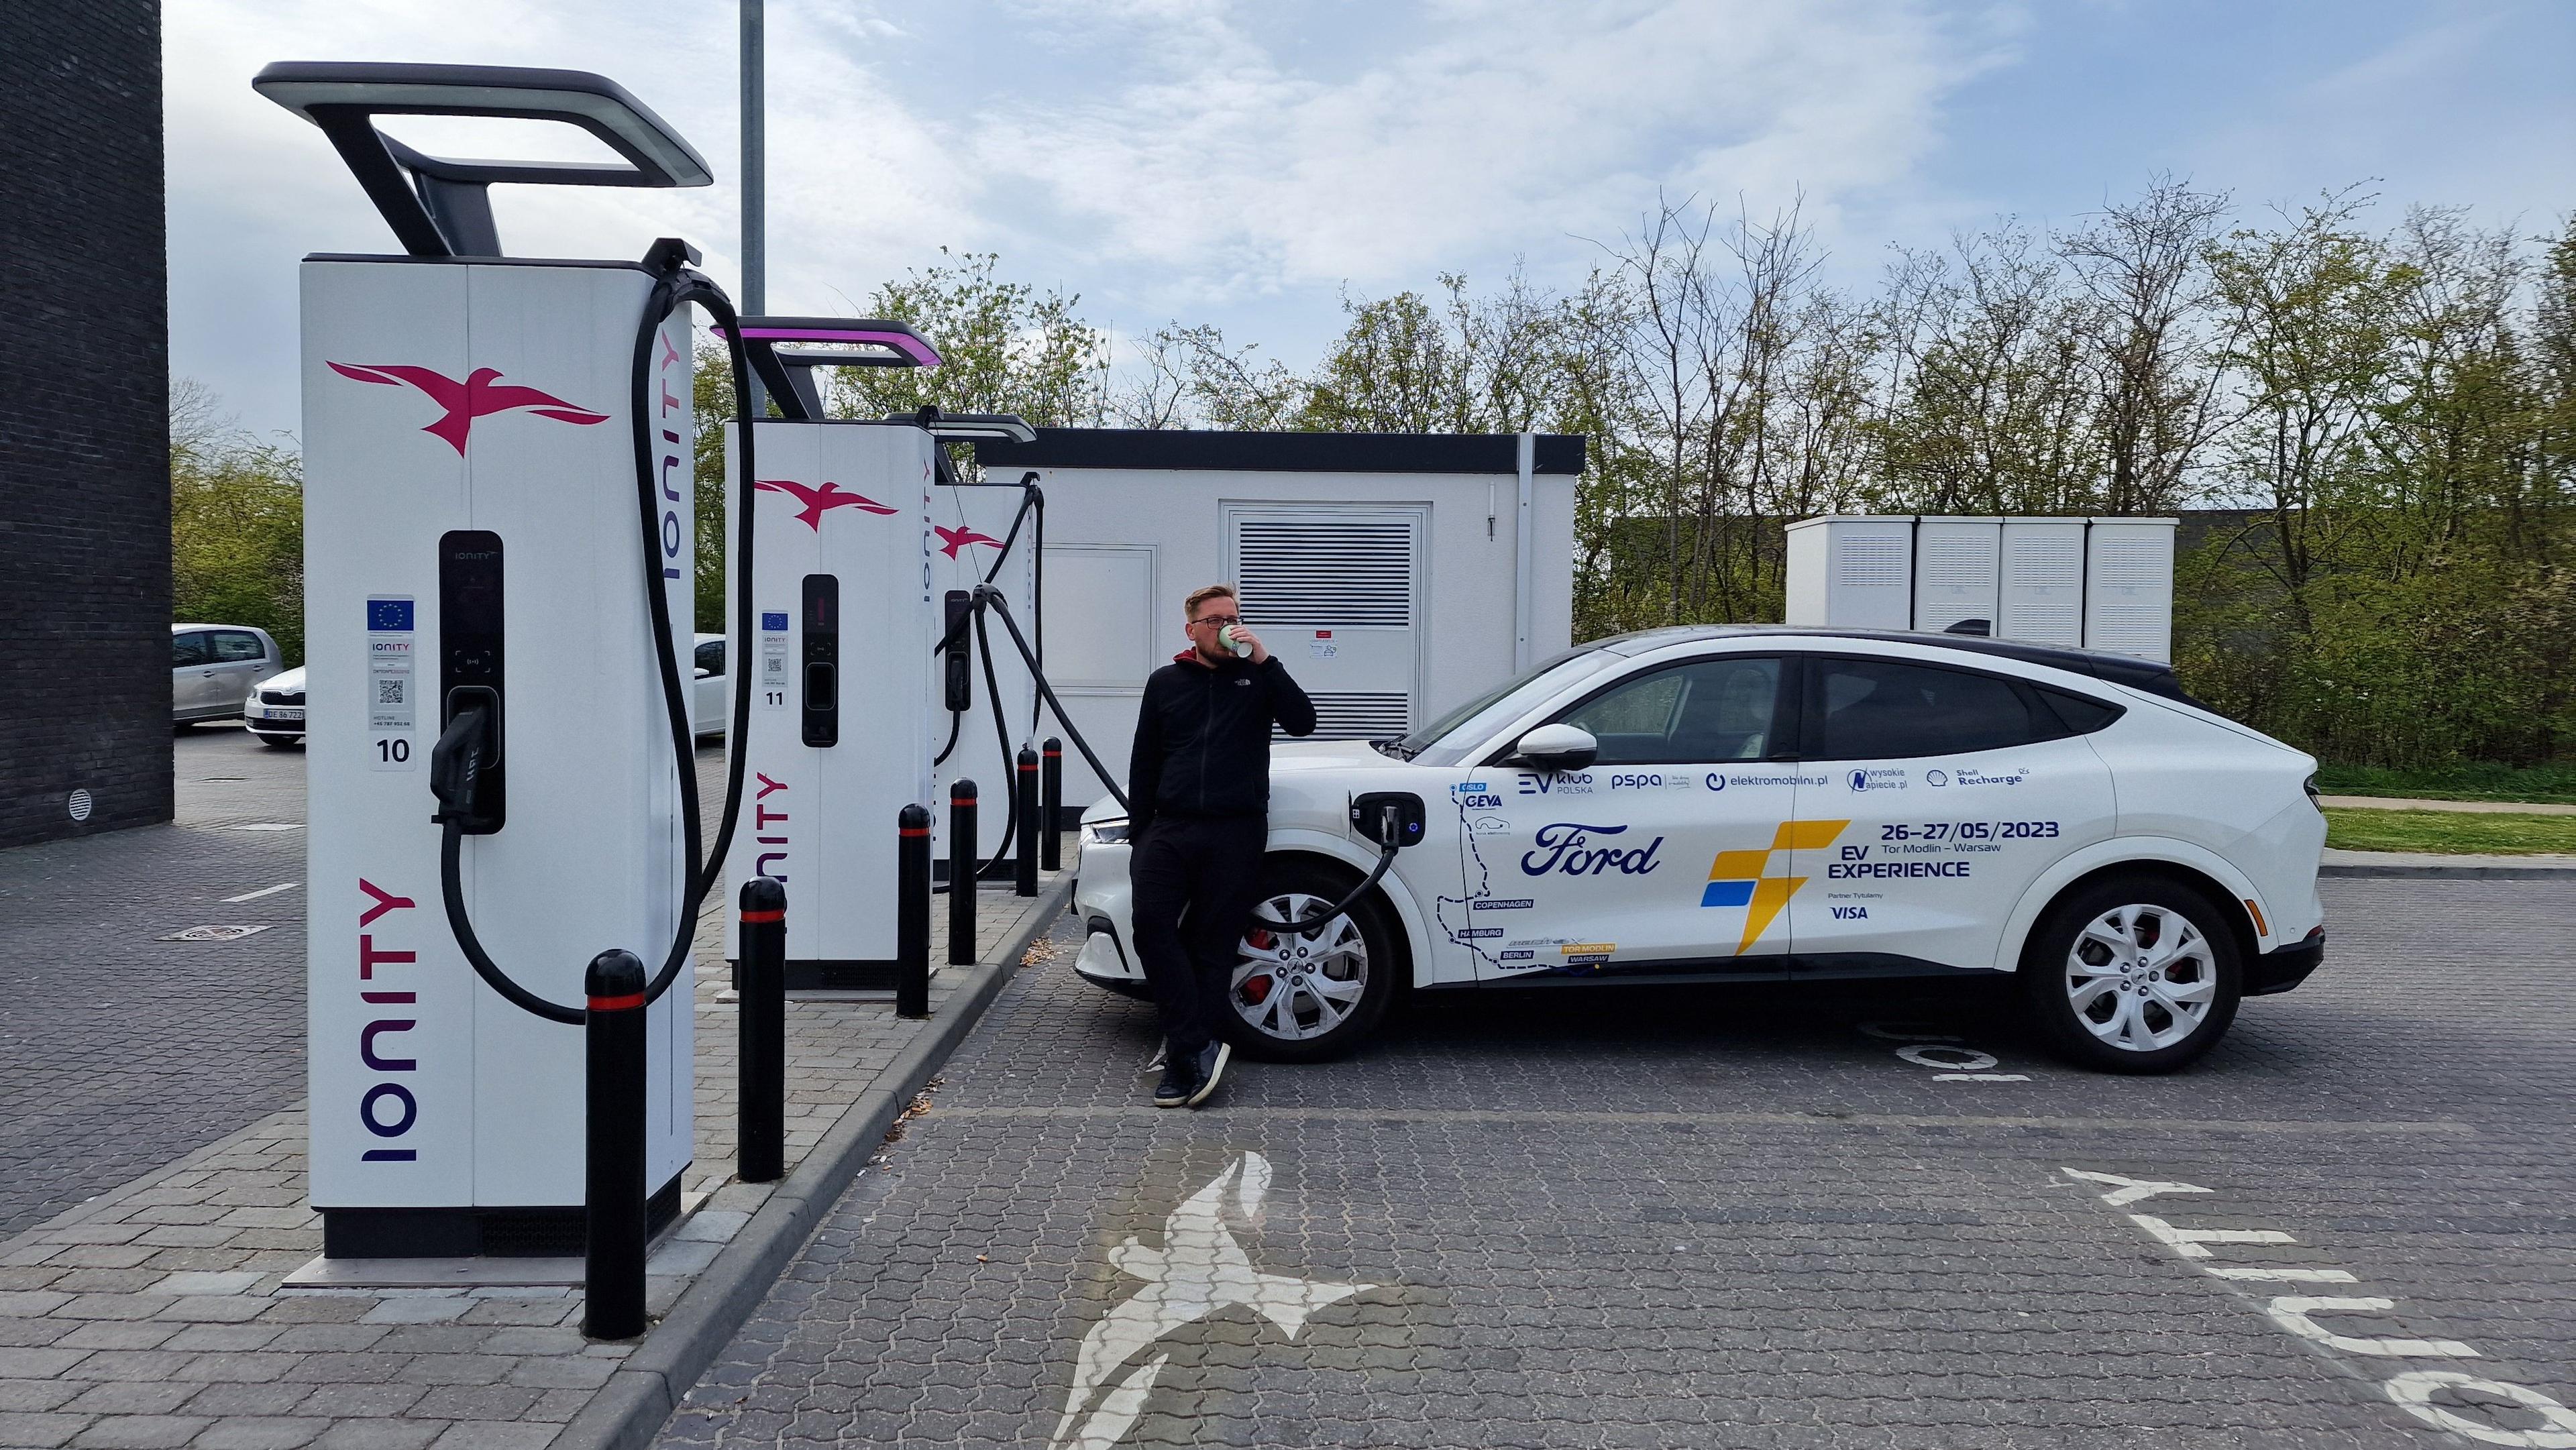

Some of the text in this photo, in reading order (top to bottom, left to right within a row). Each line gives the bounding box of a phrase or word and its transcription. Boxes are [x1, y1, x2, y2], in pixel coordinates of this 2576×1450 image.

[372, 643, 409, 651] IONITY
[766, 691, 783, 706] 11
[376, 738, 410, 763] 10
[1556, 773, 1593, 784] klub
[1870, 768, 1905, 778] wysokie
[1611, 774, 1662, 789] pspa
[1958, 775, 2023, 785] Recharge
[1557, 786, 1594, 794] POLSKA
[756, 771, 788, 883] NITY
[1521, 823, 1665, 876] Ford
[1841, 846, 1870, 860] EV
[1881, 845, 1901, 854] Tor
[1903, 844, 1941, 853] Modlin
[1953, 843, 2002, 852] Warsaw
[1828, 861, 1970, 879] EXPERIENCE
[1475, 900, 1532, 909] COPENHAGEN
[1829, 907, 1868, 919] VISA
[1460, 930, 1502, 938] HAMBURG
[1564, 944, 1615, 953] TOR MODLIN
[360, 877, 417, 1162] IONITY
[2060, 1166, 2576, 1449] ONITY
